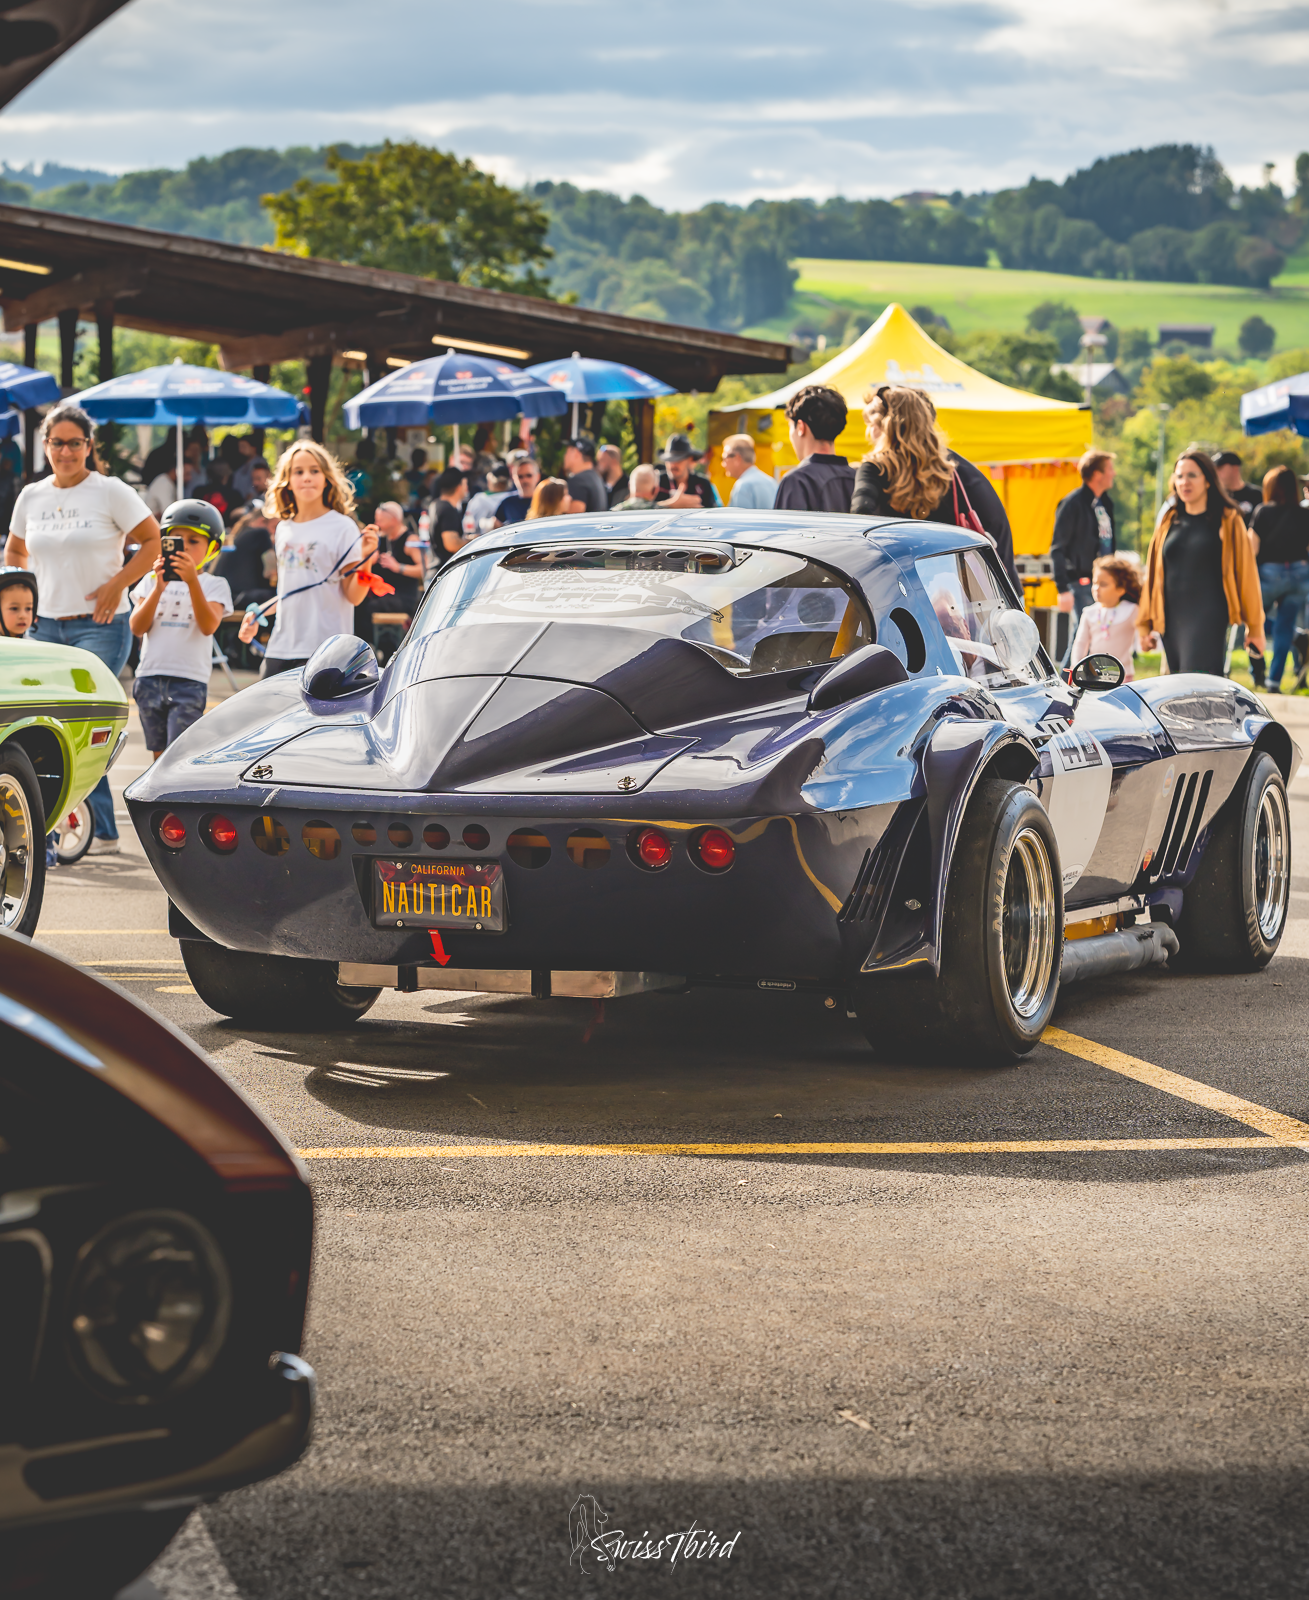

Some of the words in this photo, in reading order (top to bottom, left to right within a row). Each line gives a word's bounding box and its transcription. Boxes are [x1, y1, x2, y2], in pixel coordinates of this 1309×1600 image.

[41, 511, 56, 520] LA
[58, 508, 80, 519] VIE
[486, 592, 674, 607] NAUTICAR
[410, 864, 466, 876] CALIFORNIA
[383, 881, 492, 918] NAUTICAR
